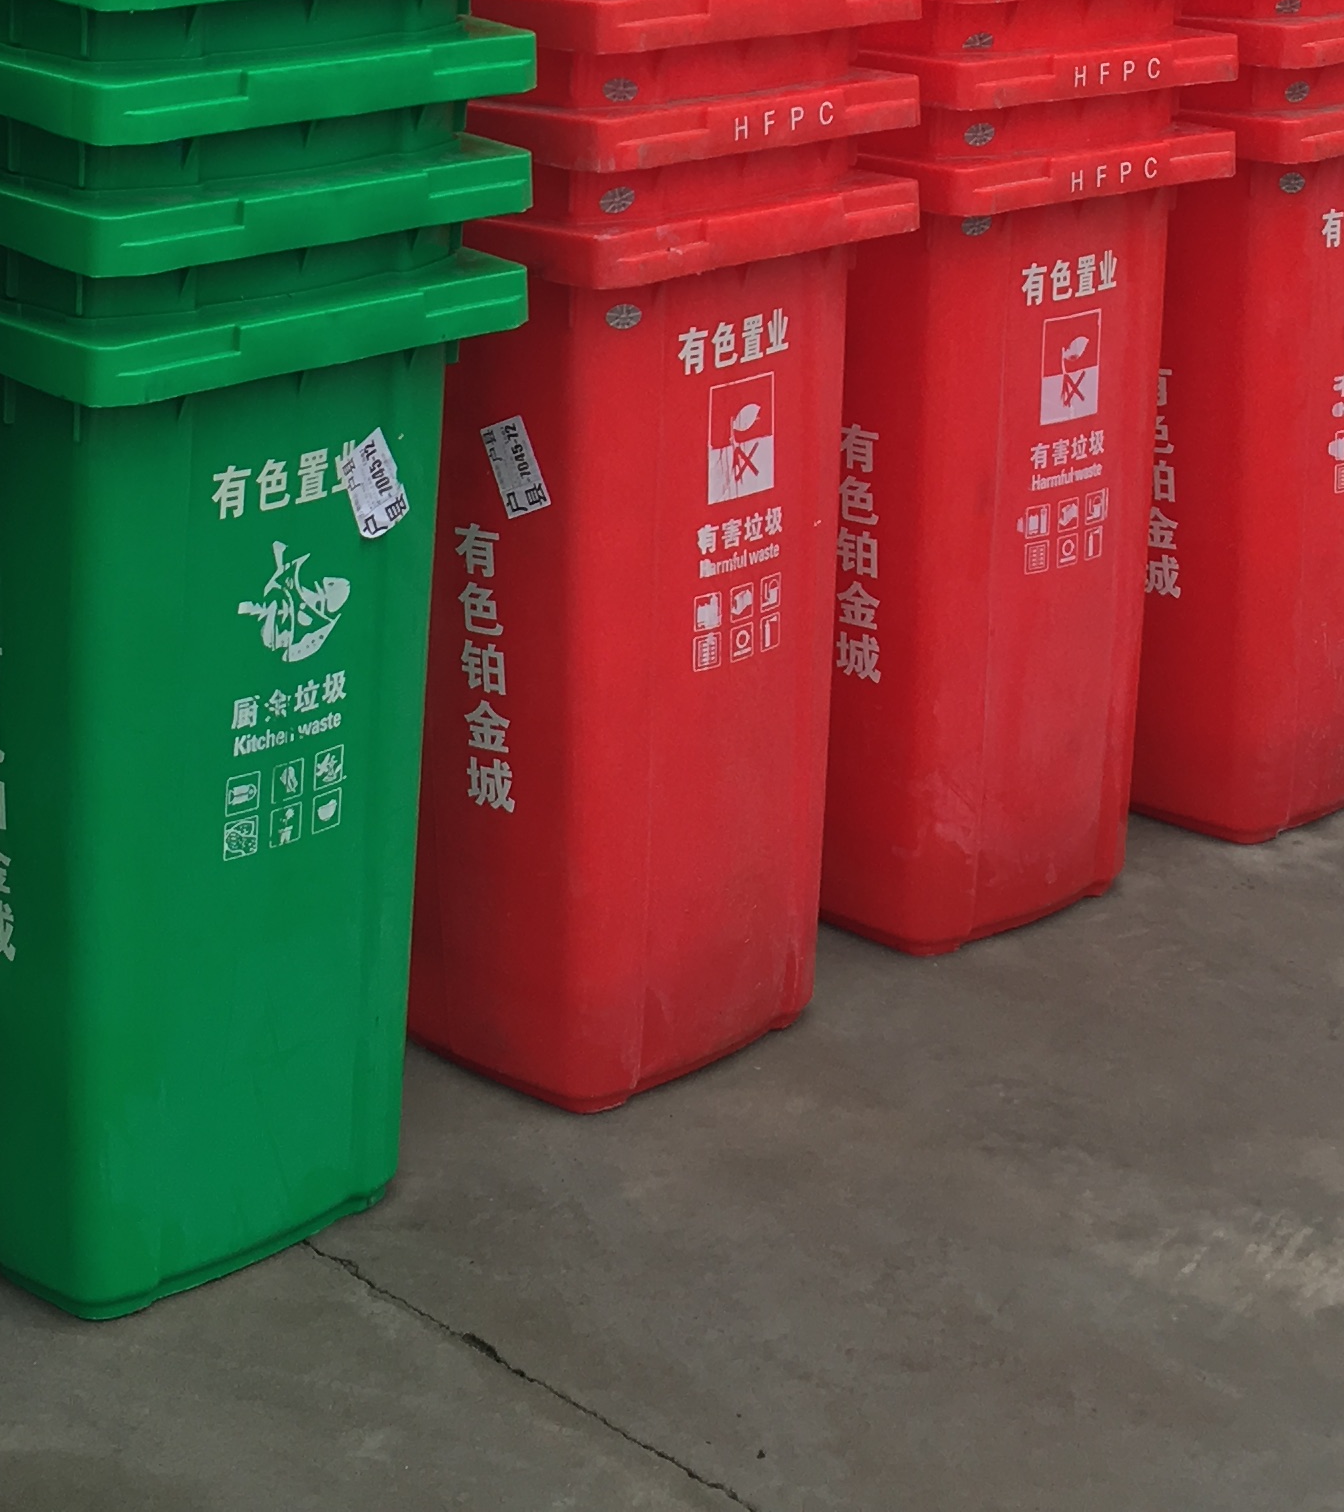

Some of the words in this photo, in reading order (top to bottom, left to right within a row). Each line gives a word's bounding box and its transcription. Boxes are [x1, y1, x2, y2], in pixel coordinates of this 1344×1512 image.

[1072, 56, 1163, 88] HFPC
[734, 100, 836, 143] HFPC
[1069, 155, 1160, 194] HFPC
[1021, 249, 1118, 306] 有色置业
[678, 308, 789, 376] 有色置业
[1030, 429, 1105, 470] 有害垃圾
[212, 439, 358, 520] 有色置业
[697, 506, 783, 555] 有害垃圾
[748, 542, 780, 565] waste
[836, 424, 882, 684] 有色铂金城
[455, 523, 515, 814] 有色铂金城
[231, 670, 347, 730] 厨余垃圾
[297, 712, 342, 736] waste
